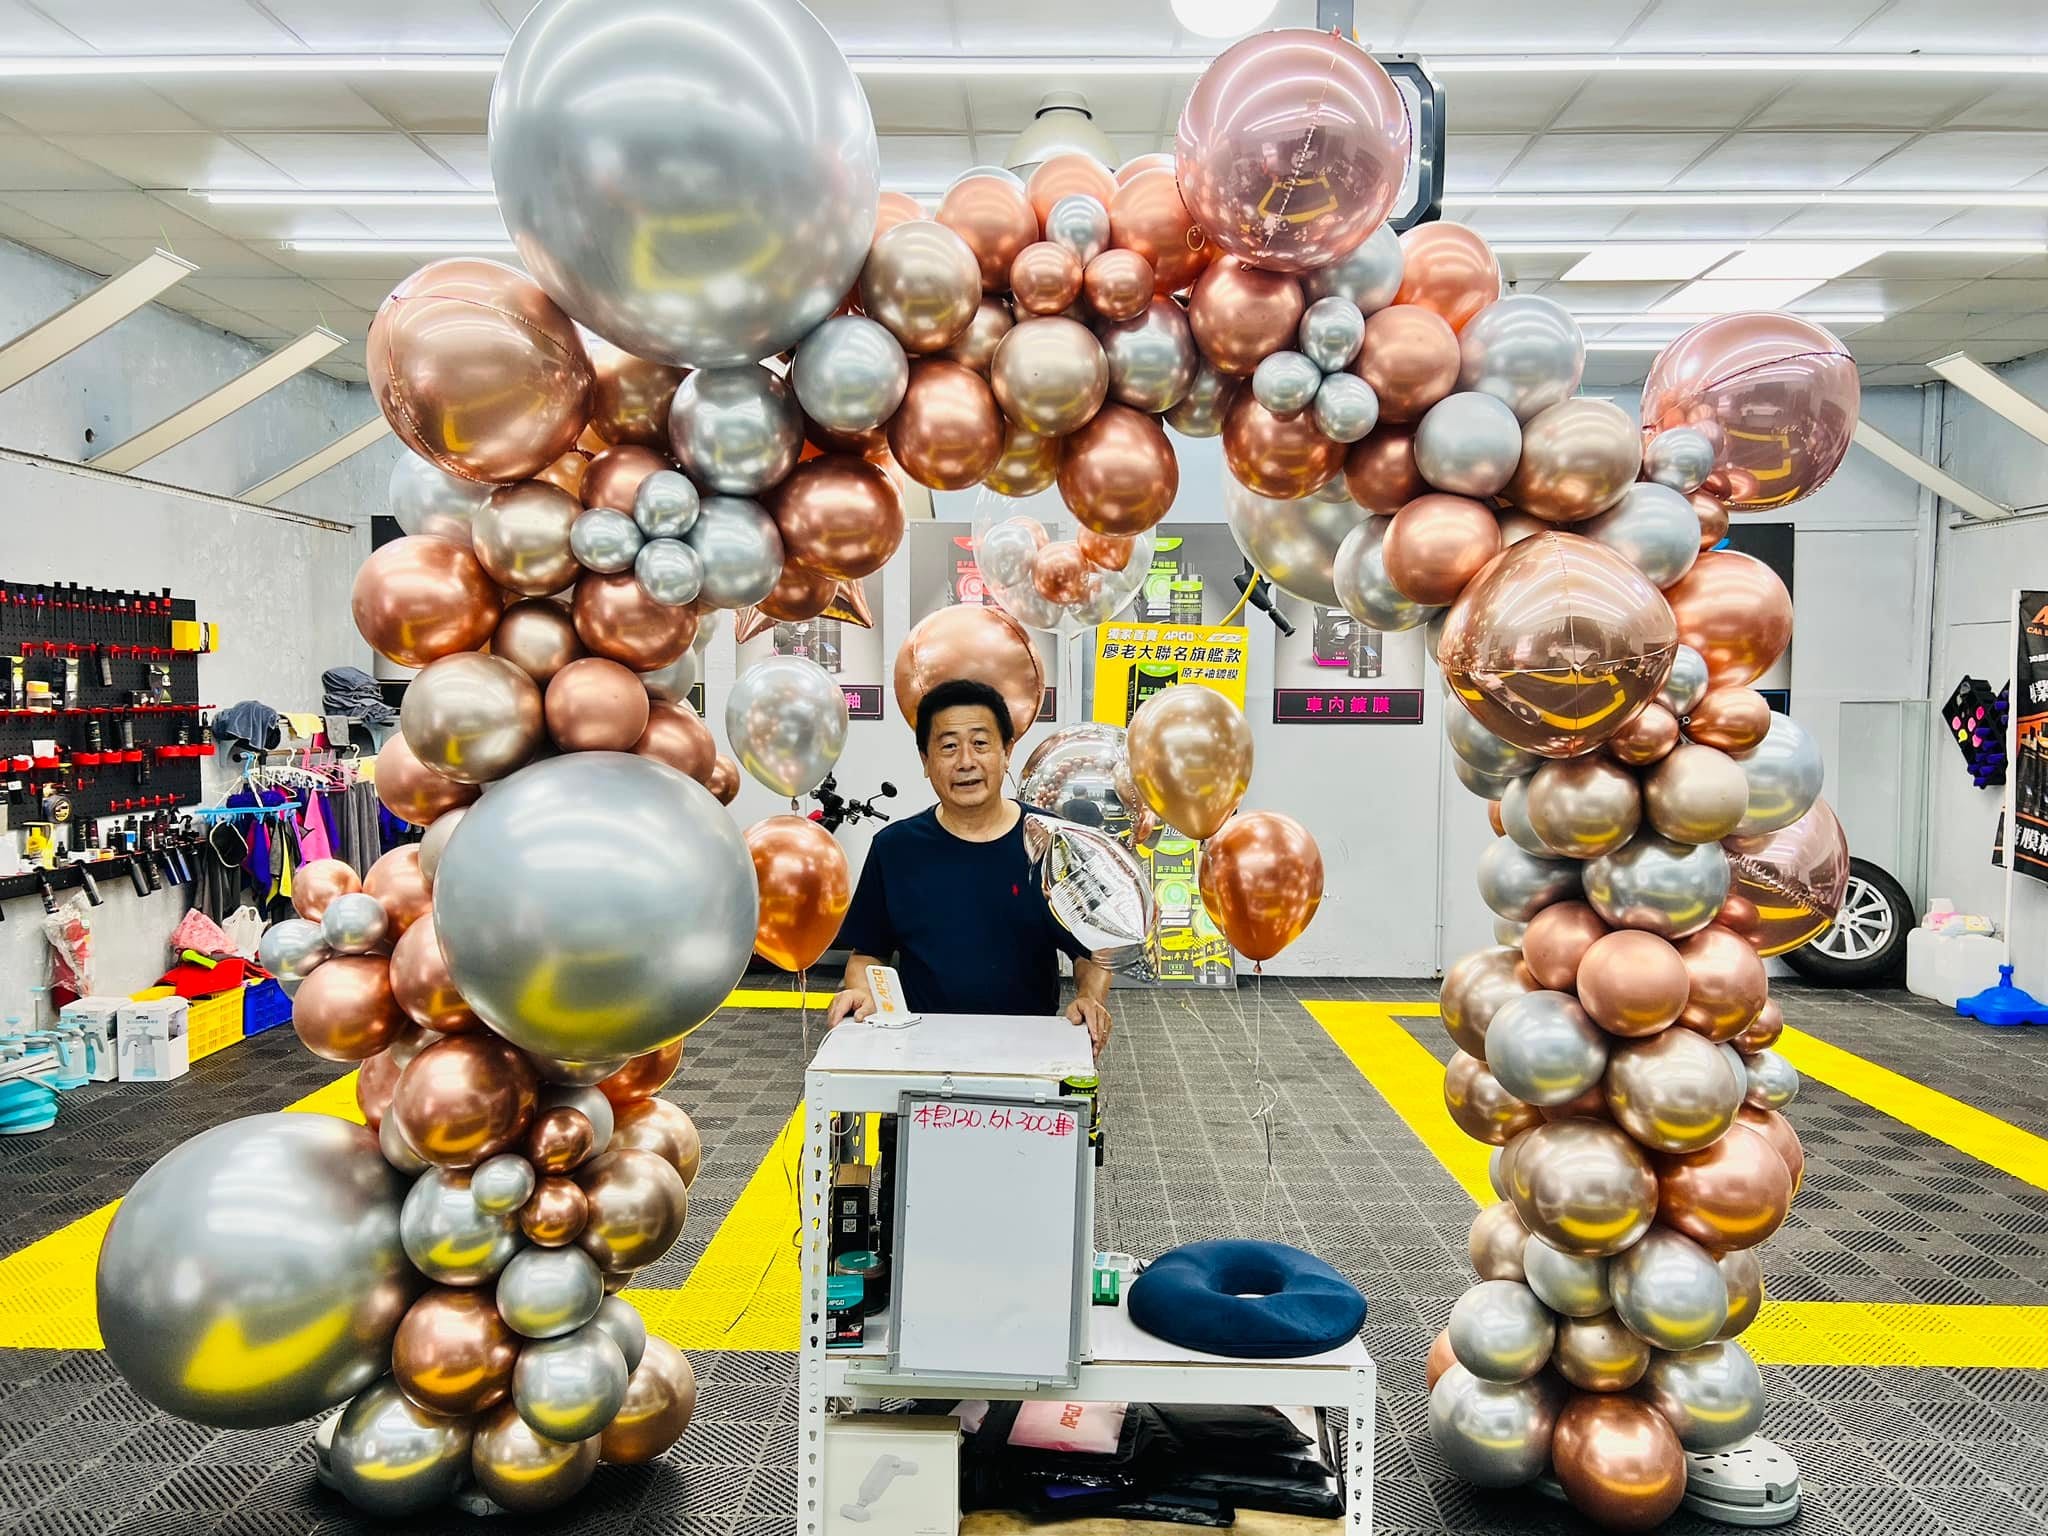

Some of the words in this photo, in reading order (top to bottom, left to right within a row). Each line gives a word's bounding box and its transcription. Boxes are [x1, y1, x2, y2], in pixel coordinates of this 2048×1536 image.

[1163, 631, 1195, 642] APGO
[1102, 643, 1242, 664] 廖老大聯名旗艦款
[1305, 695, 1391, 713] 車內鍍膜
